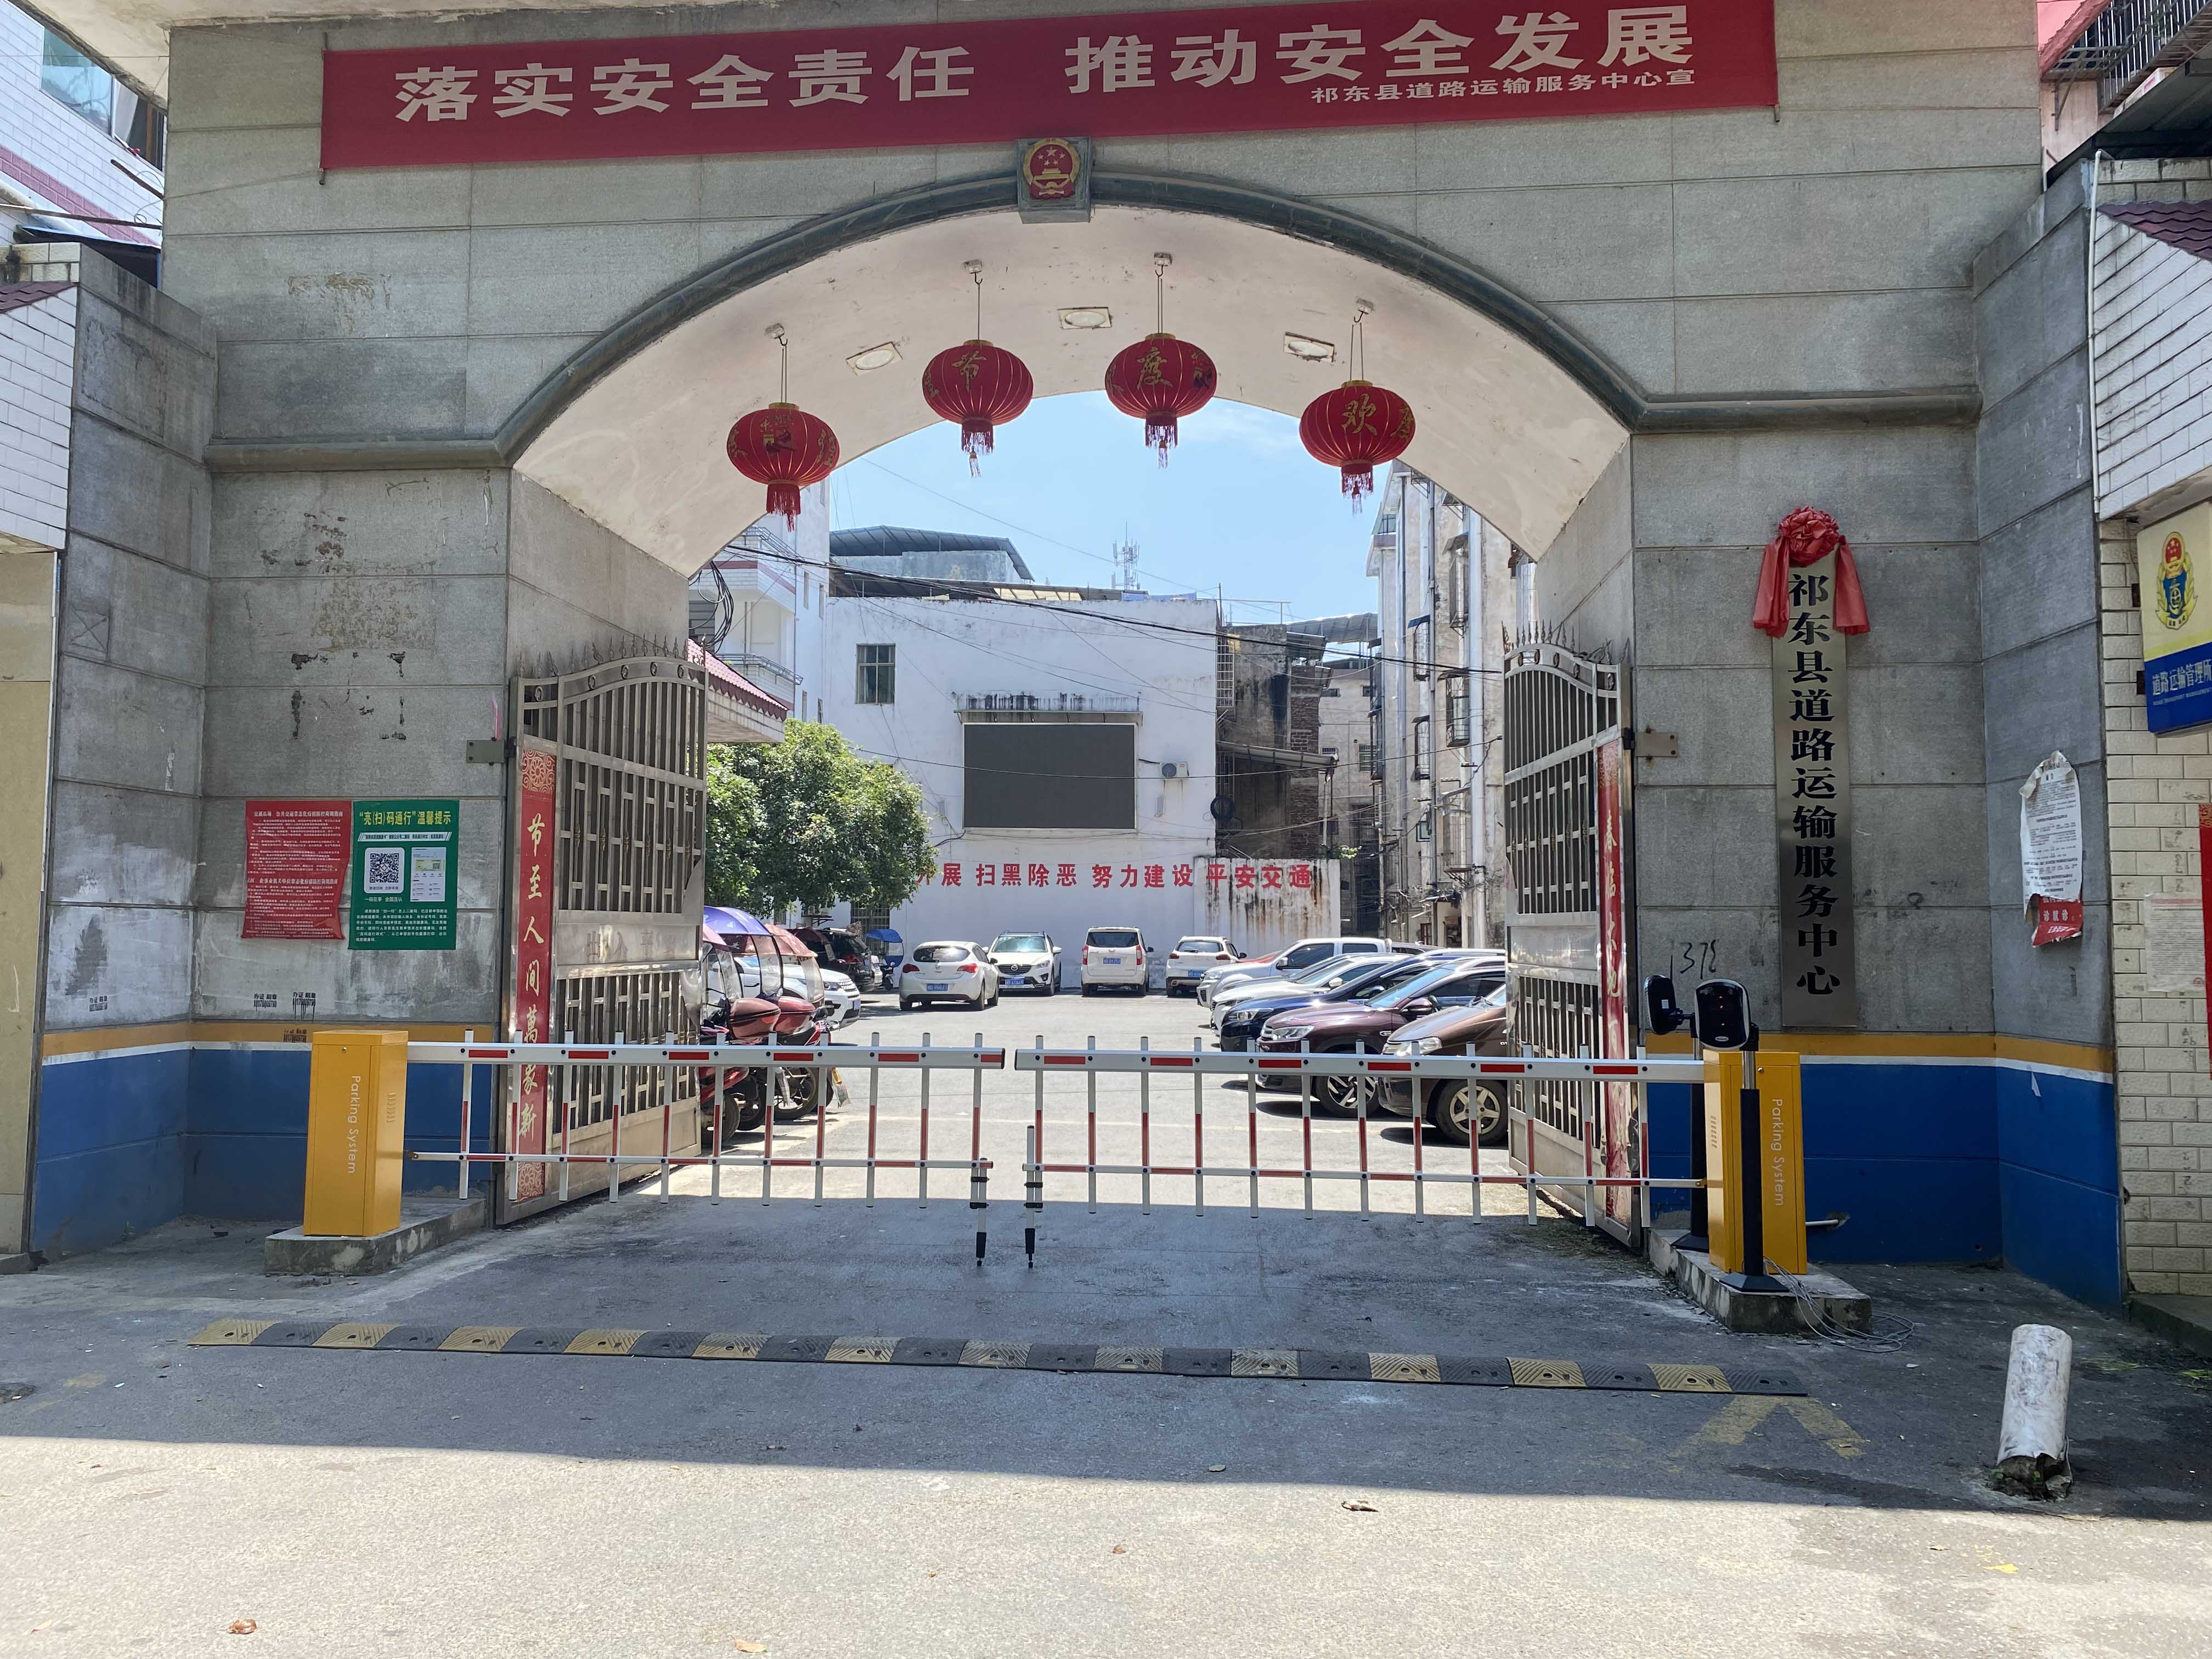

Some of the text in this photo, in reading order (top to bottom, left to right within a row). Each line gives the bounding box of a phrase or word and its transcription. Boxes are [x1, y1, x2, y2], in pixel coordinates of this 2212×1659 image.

[395, 4, 1694, 123] 落实安全责任 推动安全发展
[1311, 69, 1696, 104] 祁东县道路运输服务中心宣
[1341, 393, 1378, 436] 欢
[2152, 658, 2212, 696] 道路运输管理所
[1787, 574, 1841, 996] 祁东县道路运输服务中心
[975, 863, 1077, 887] 扫黑除恶
[1092, 864, 1194, 888] 努力建设
[1207, 864, 1312, 889] 平安交通
[347, 1075, 361, 1174] Parking System
[1770, 1098, 1785, 1206] Parking System
